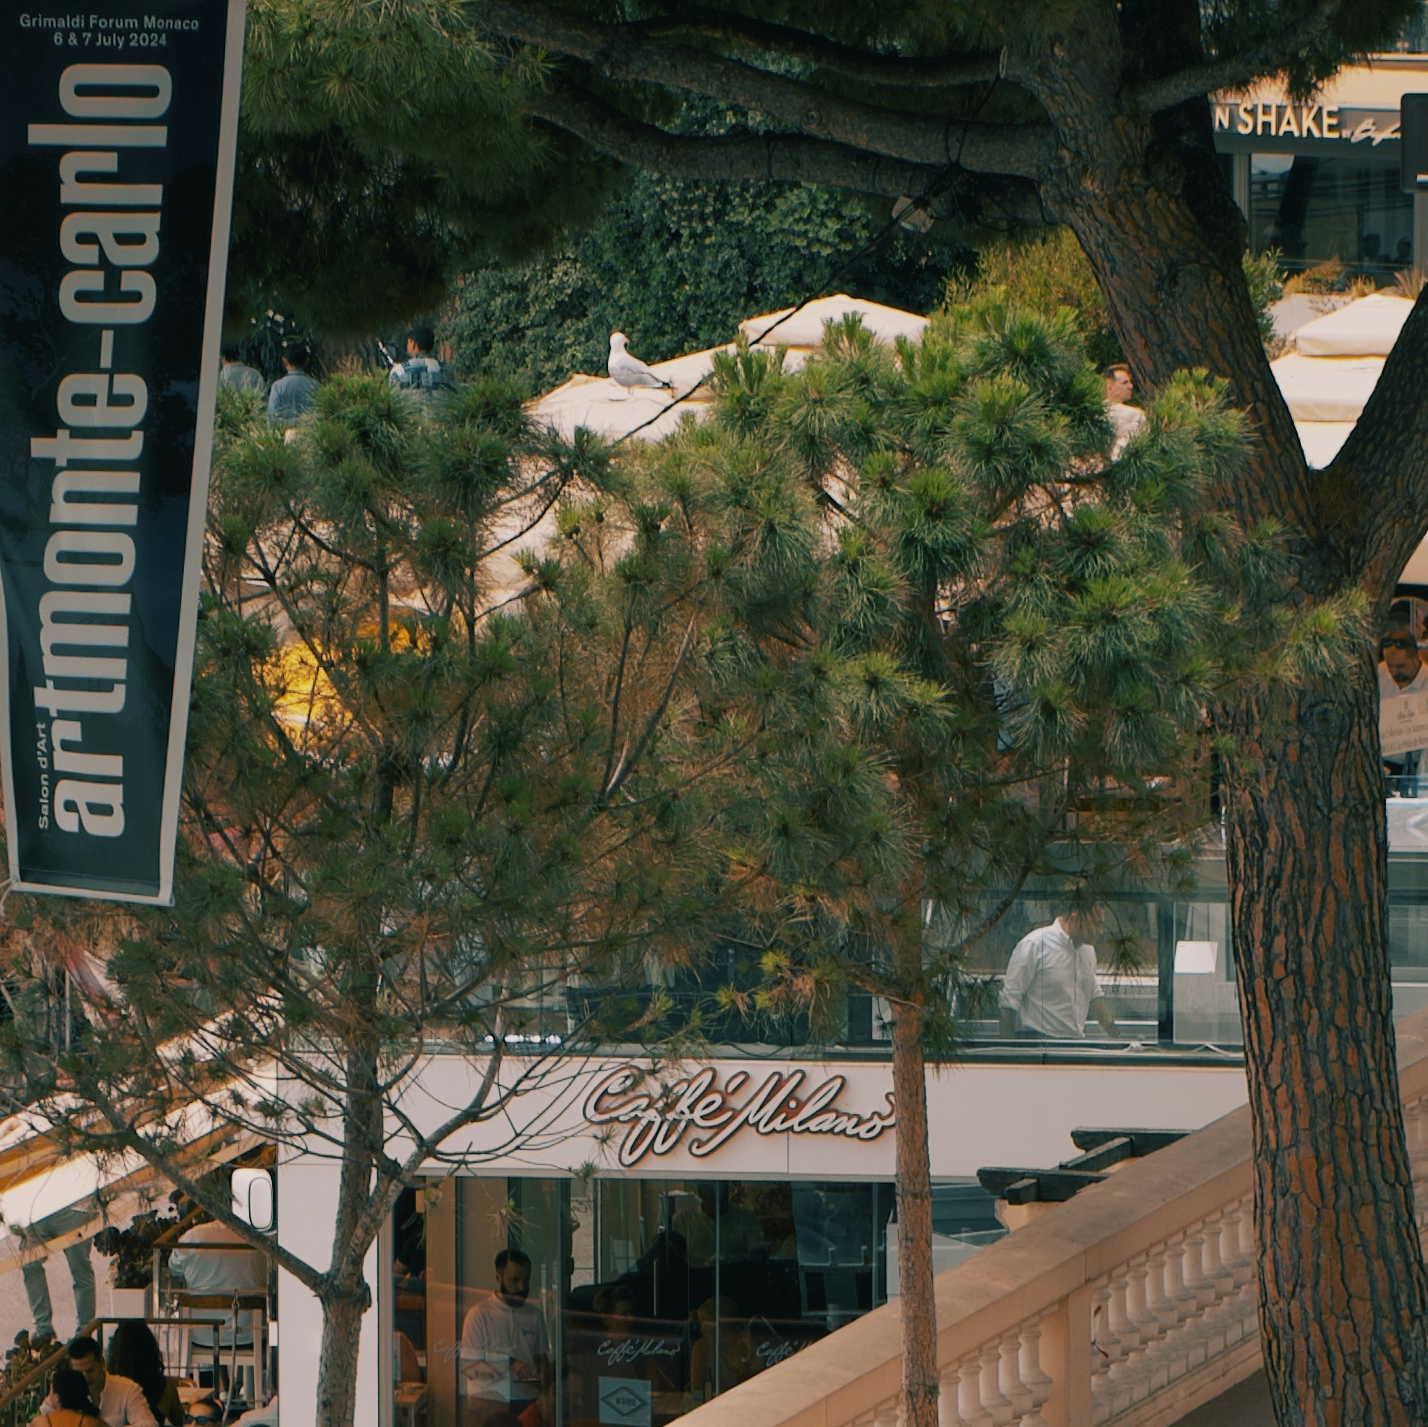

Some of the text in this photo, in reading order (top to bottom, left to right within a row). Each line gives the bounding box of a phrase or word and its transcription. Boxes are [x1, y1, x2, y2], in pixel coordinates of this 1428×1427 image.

[19, 13, 199, 30] Grimaldi Forum Monaco
[53, 32, 167, 49] 6 & 7 July 2024
[1237, 102, 1339, 139] SHAKE
[27, 62, 173, 838] artmonte-carlo
[36, 722, 49, 829] Salon d'Art
[688, 1069, 896, 1158] Milano
